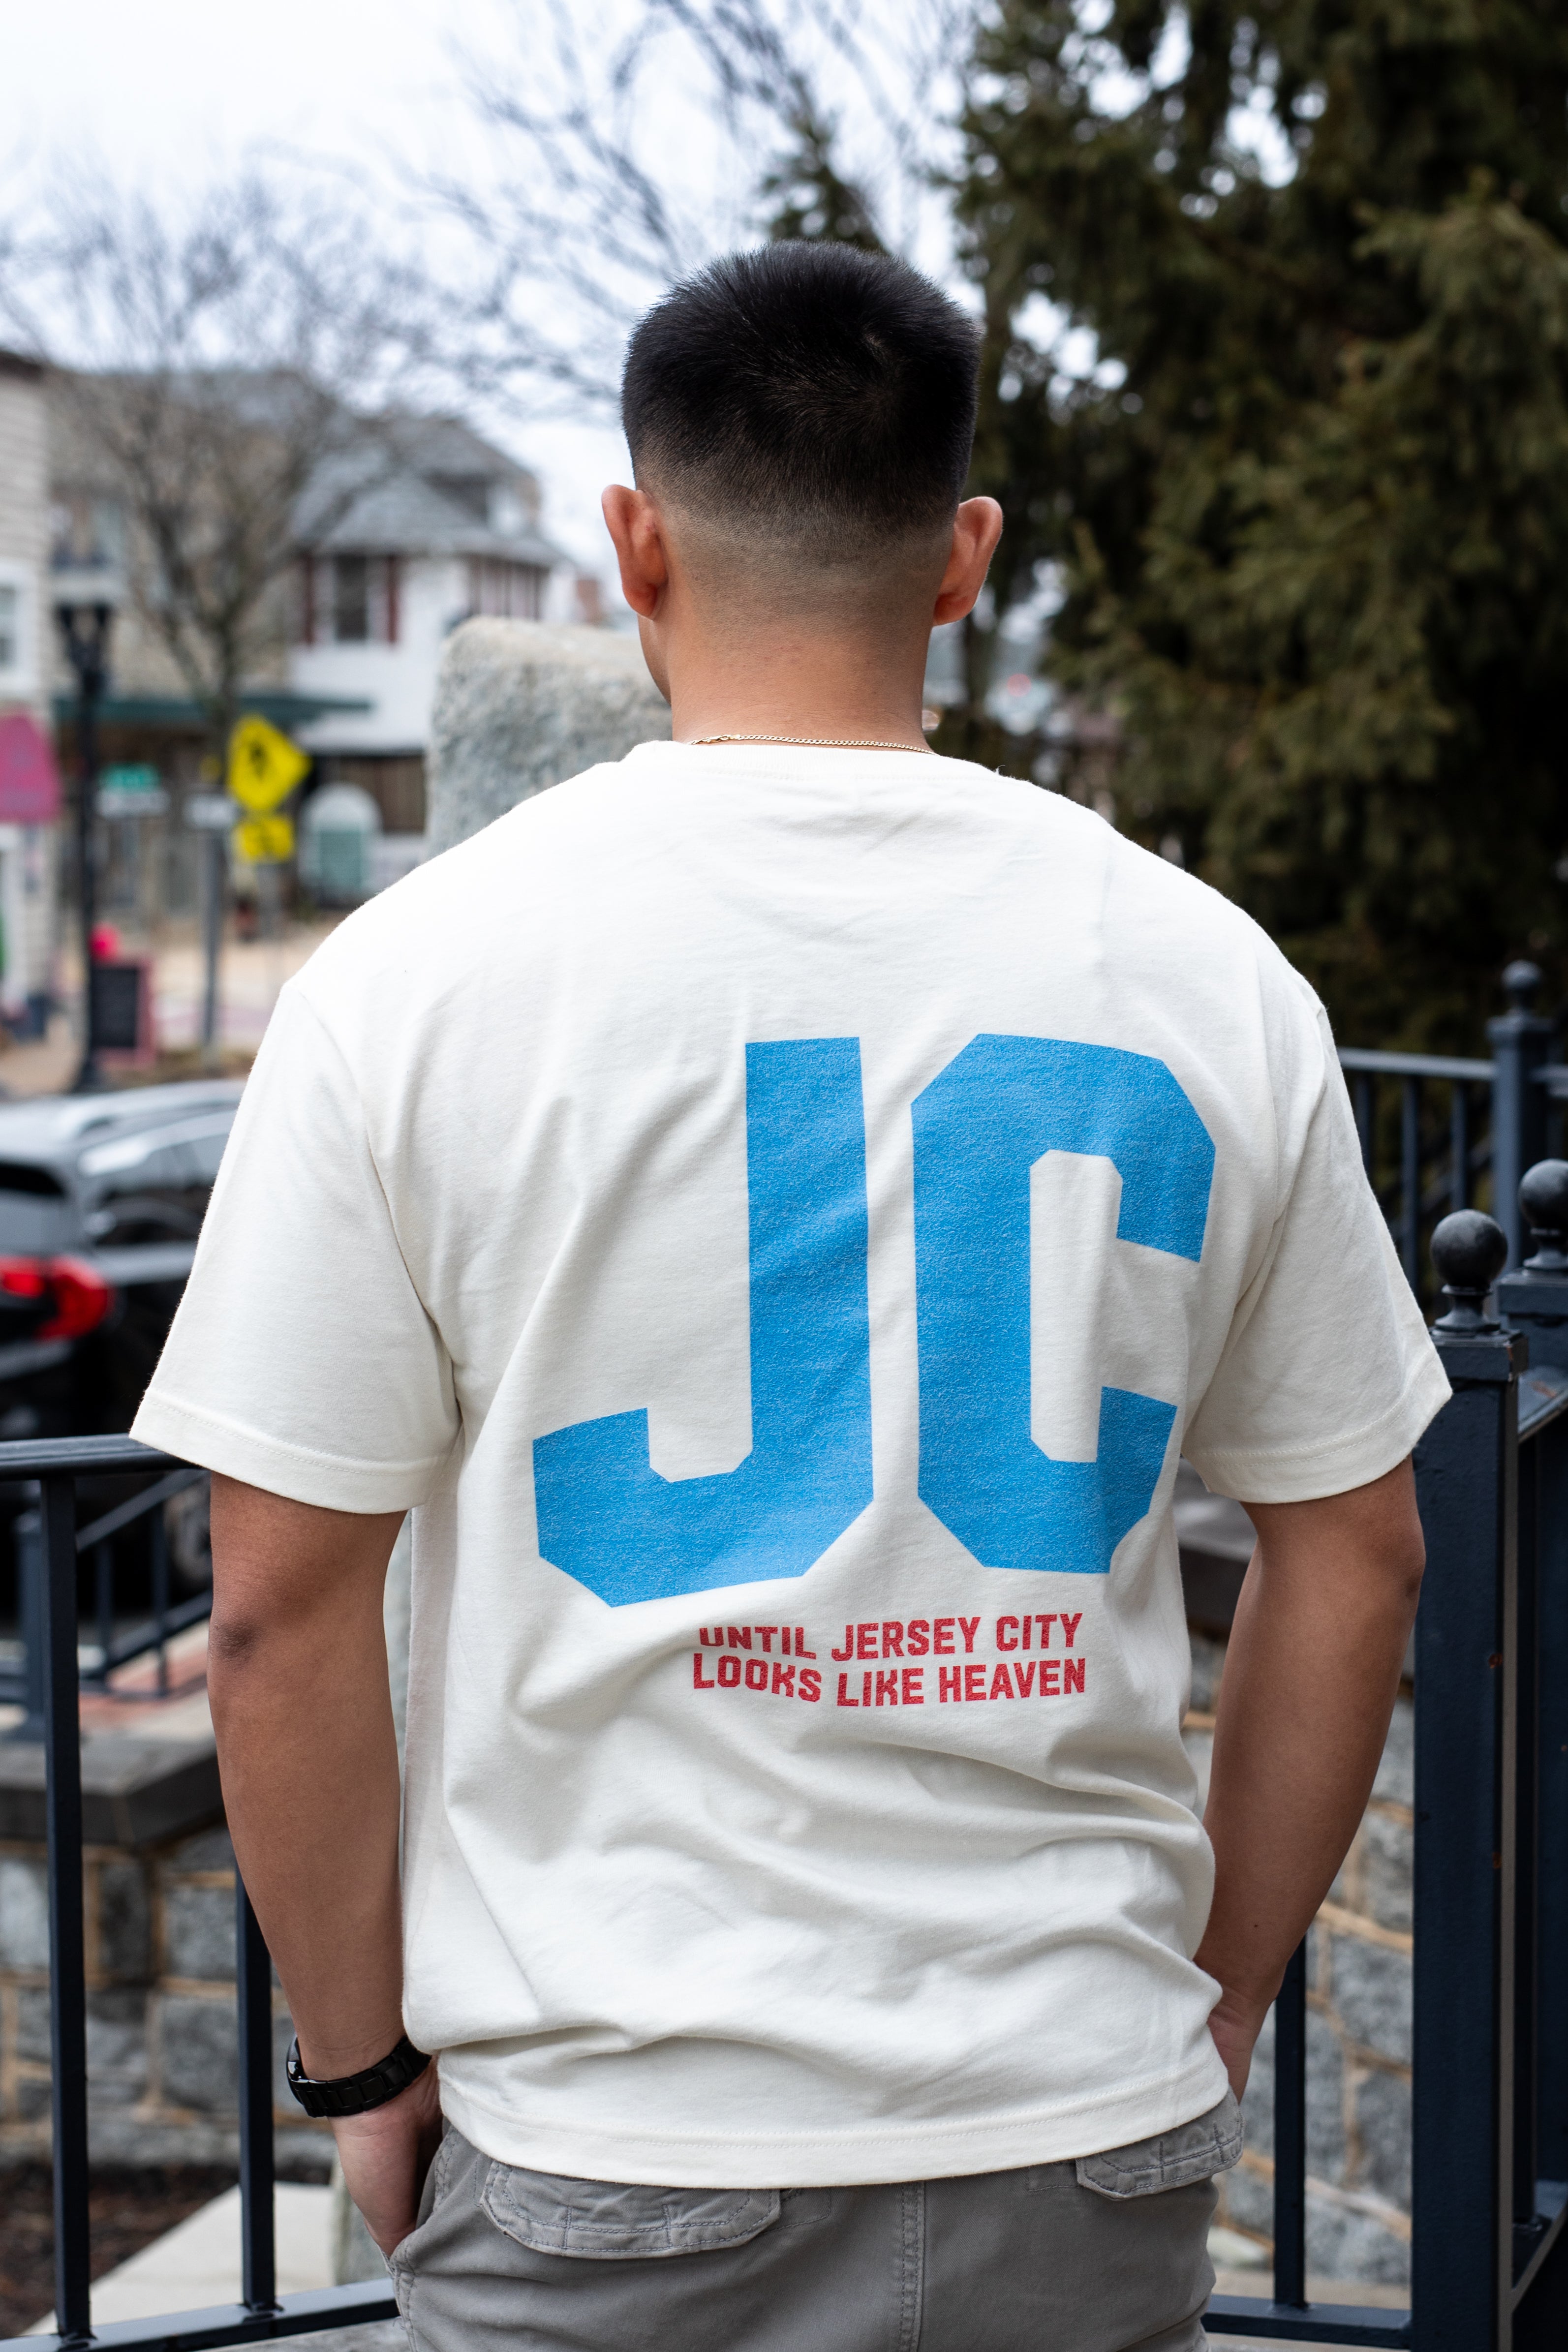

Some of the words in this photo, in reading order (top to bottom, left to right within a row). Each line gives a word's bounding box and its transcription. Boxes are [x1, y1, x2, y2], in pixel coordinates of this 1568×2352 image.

[533, 1034, 1216, 1607] JC
[699, 1626, 817, 1660] UNTIL
[831, 1617, 981, 1661] JERSEY
[996, 1613, 1082, 1651] CITY
[693, 1653, 822, 1703] LOOKS
[837, 1668, 924, 1707] LIKE
[939, 1658, 1086, 1703] HEAVEN
